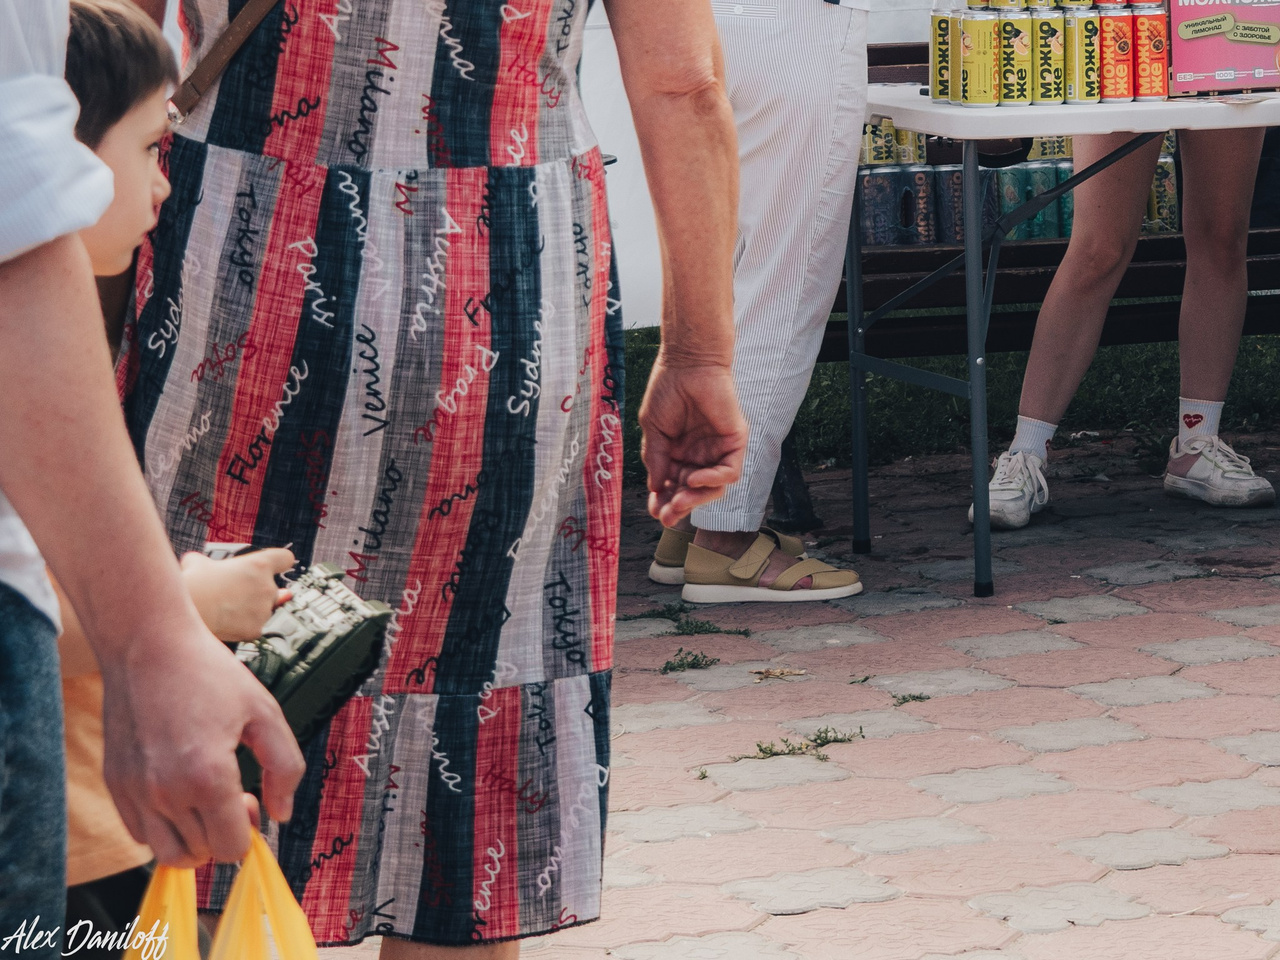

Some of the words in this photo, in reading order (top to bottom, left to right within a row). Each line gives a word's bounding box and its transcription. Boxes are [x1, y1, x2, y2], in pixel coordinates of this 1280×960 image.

[1184, 15, 1228, 30] УНИКАЛЬНЫЙ
[1191, 24, 1222, 35] ЛИМОНАД
[1239, 32, 1272, 40] ЗДОРОВЬЕ
[1241, 25, 1270, 33] ЗАБОТОЙ
[348, 36, 400, 165] Milano
[506, 53, 562, 109] Italy
[230, 183, 258, 295] Tokyo
[411, 206, 463, 342] Austria
[190, 330, 258, 384] Sofia
[352, 323, 391, 437] Venice
[413, 343, 500, 447] Prague
[506, 298, 557, 418] Sydney
[225, 359, 310, 486] Florence
[345, 458, 403, 583] Milano
[543, 571, 588, 668] Tokyo
